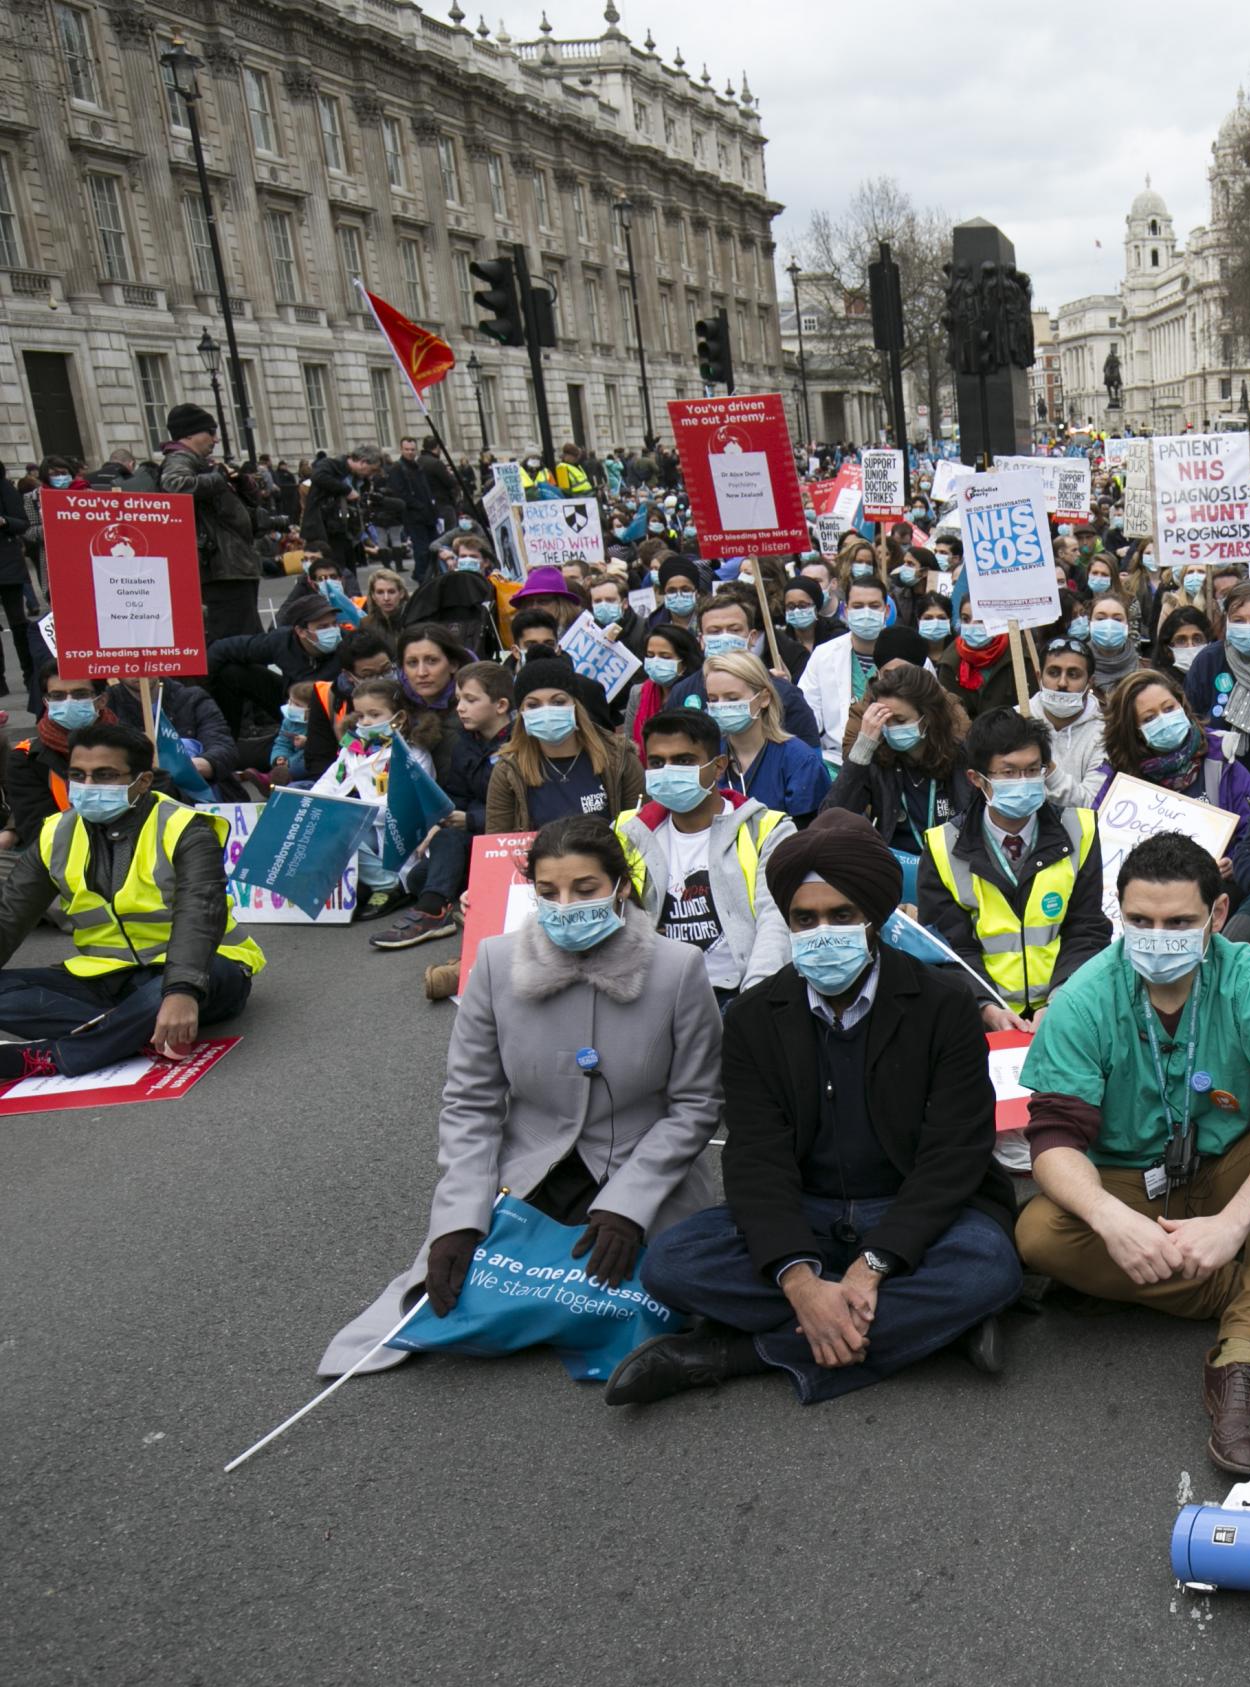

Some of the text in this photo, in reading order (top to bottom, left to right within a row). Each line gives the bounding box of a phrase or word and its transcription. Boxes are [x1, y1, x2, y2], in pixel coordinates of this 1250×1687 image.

[686, 401, 765, 414] You've driven
[681, 418, 698, 426] me
[702, 416, 720, 425] out
[864, 458, 896, 469] SUPPORT
[865, 470, 888, 480] JUNIOR
[1178, 460, 1224, 481] NHS
[1059, 473, 1085, 482] SUPPORT
[865, 481, 898, 492] DOCTORS'
[66, 496, 171, 510] You've driven
[865, 493, 894, 504] STRIKES
[1058, 500, 1082, 509] STRIKES
[56, 511, 182, 524] me out Jeremy...
[1126, 504, 1146, 518] OUR
[1190, 503, 1248, 522] HUNT
[819, 521, 840, 530] Hands
[970, 504, 1036, 542] NHS
[1126, 518, 1148, 531] NHS
[530, 537, 599, 550] STAND WITH
[704, 534, 724, 542] STOP
[725, 533, 756, 541] bleeding
[721, 542, 790, 554] time to listen
[976, 534, 1040, 570] SOS
[542, 550, 586, 563] THE BMA
[66, 650, 94, 659] STOP
[96, 649, 140, 658] bleeding
[160, 648, 180, 656] NHS
[183, 648, 199, 656] dry
[88, 662, 181, 674] time to listen
[161, 727, 179, 740] We
[1148, 792, 1186, 821] Your
[485, 850, 508, 858] me
[592, 907, 609, 921] DRS
[665, 921, 718, 941] DOCTORS
[1166, 939, 1190, 952] FOR
[488, 1250, 565, 1280] are one
[470, 1268, 638, 1320] We stand together
